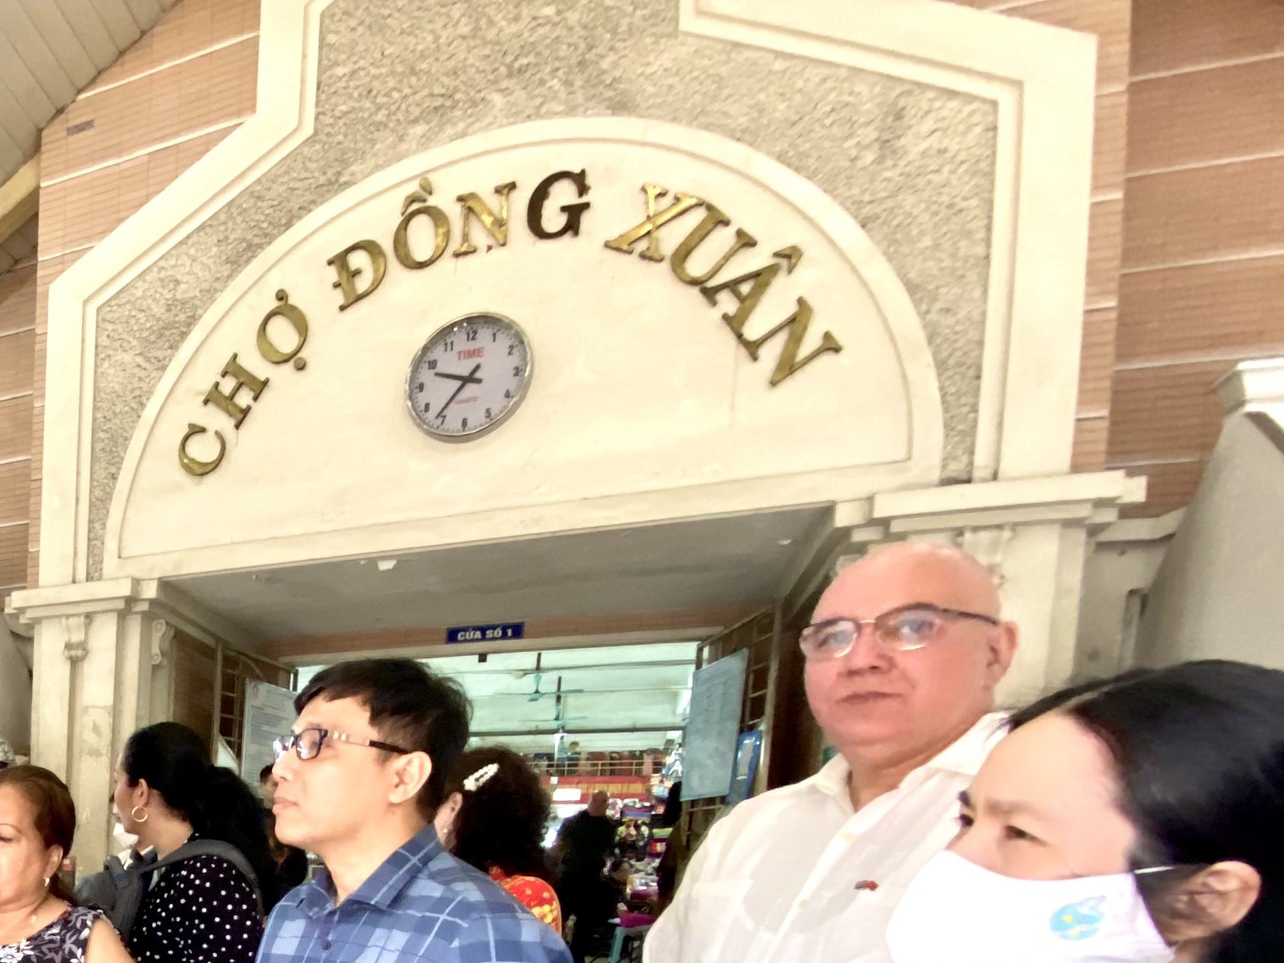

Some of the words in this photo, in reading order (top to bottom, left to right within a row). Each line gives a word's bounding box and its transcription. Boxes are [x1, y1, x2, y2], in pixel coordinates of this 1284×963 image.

[177, 288, 310, 476] CHỢ
[327, 168, 592, 312] ĐỒNG
[604, 182, 843, 388] XUÂN
[466, 329, 478, 342] 12
[491, 332, 497, 343] 1
[444, 341, 454, 352] 11
[507, 344, 514, 356] 2
[457, 346, 485, 361] TIME
[427, 359, 438, 370] 10
[513, 366, 520, 377] 3
[418, 382, 424, 393] 9
[504, 388, 511, 399] 4
[424, 402, 430, 413] 8
[485, 407, 491, 418] 5
[440, 415, 447, 426] 7
[462, 417, 468, 429] 6
[485, 626, 503, 639] SỐ
[506, 628, 512, 638] 1
